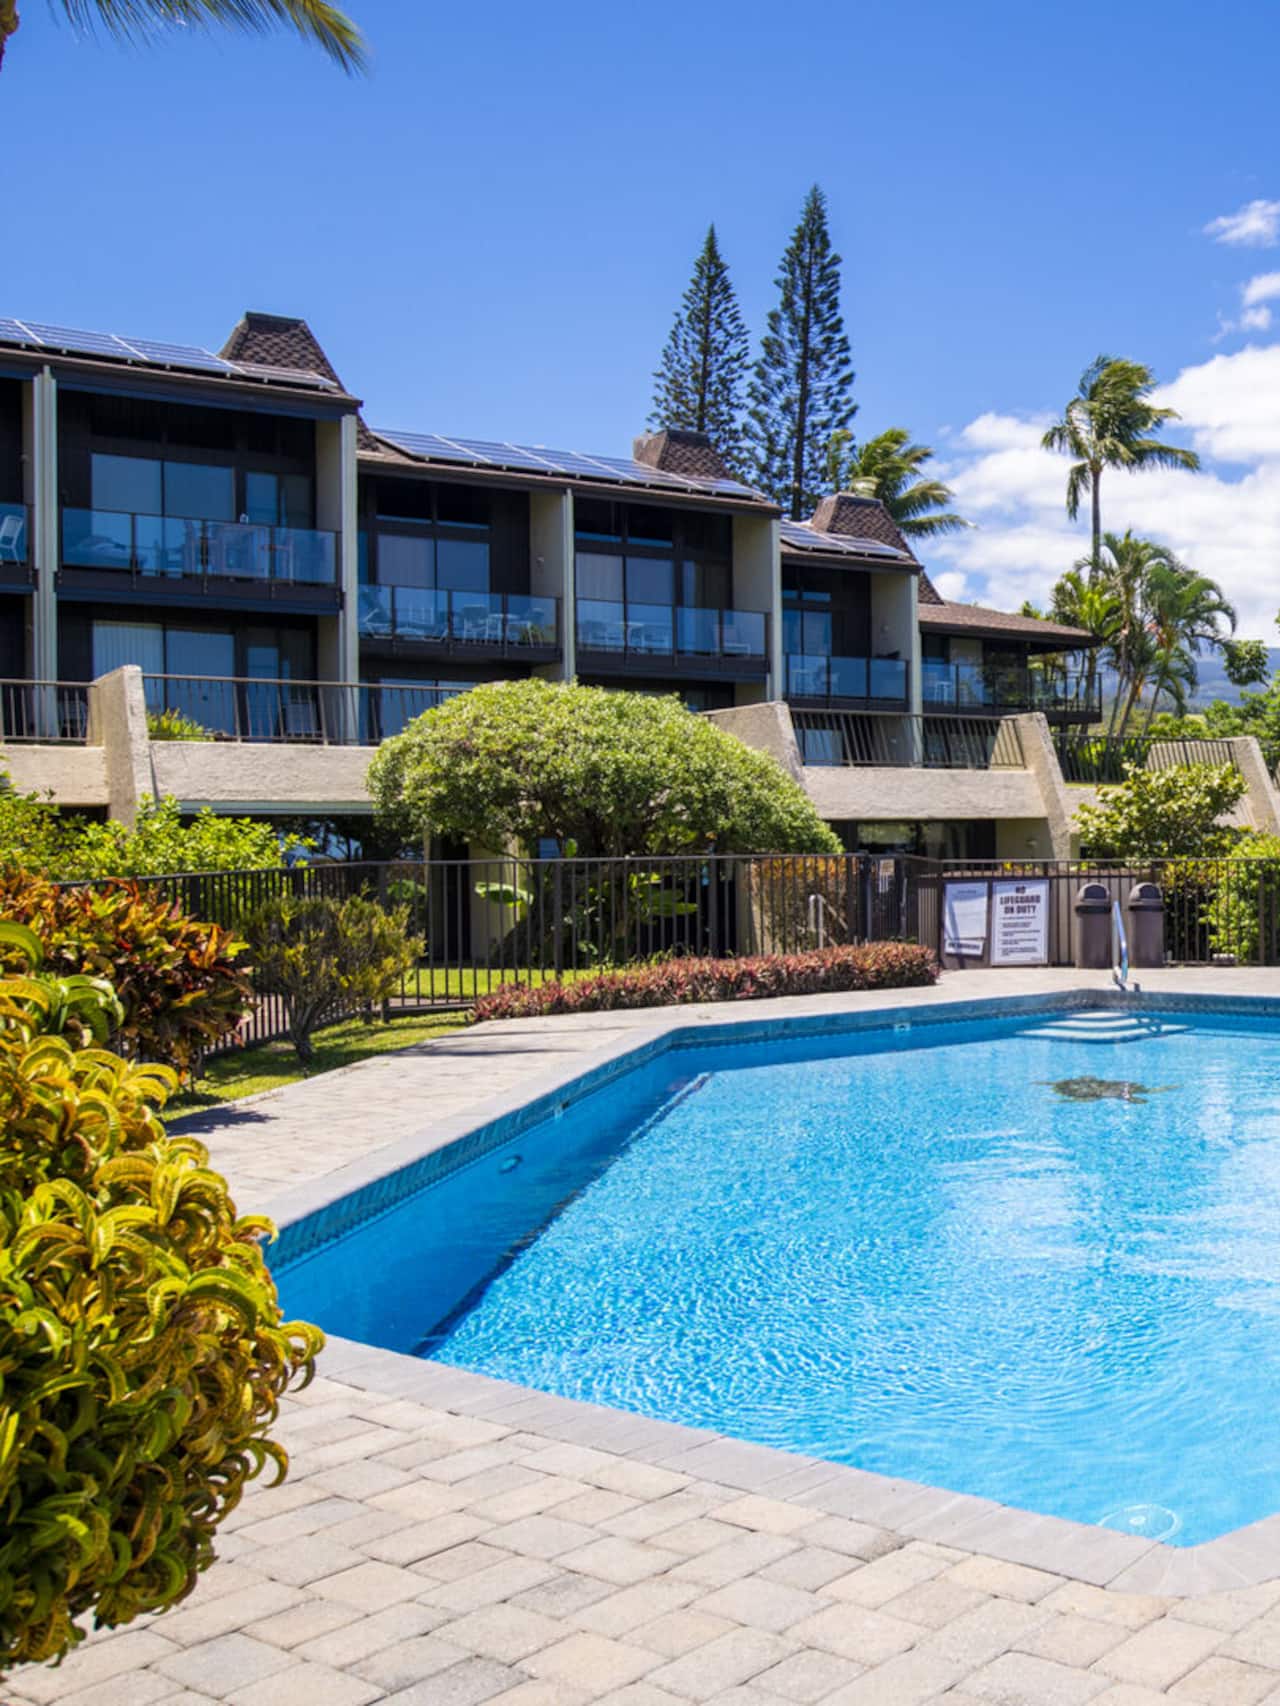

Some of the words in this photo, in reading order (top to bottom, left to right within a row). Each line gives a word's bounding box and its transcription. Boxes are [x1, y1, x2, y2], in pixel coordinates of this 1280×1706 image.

[1015, 886, 1026, 894] NO
[1000, 895, 1041, 905] LIFEGUARD
[1004, 905, 1014, 914] ON
[1016, 905, 1036, 914] DUTY
